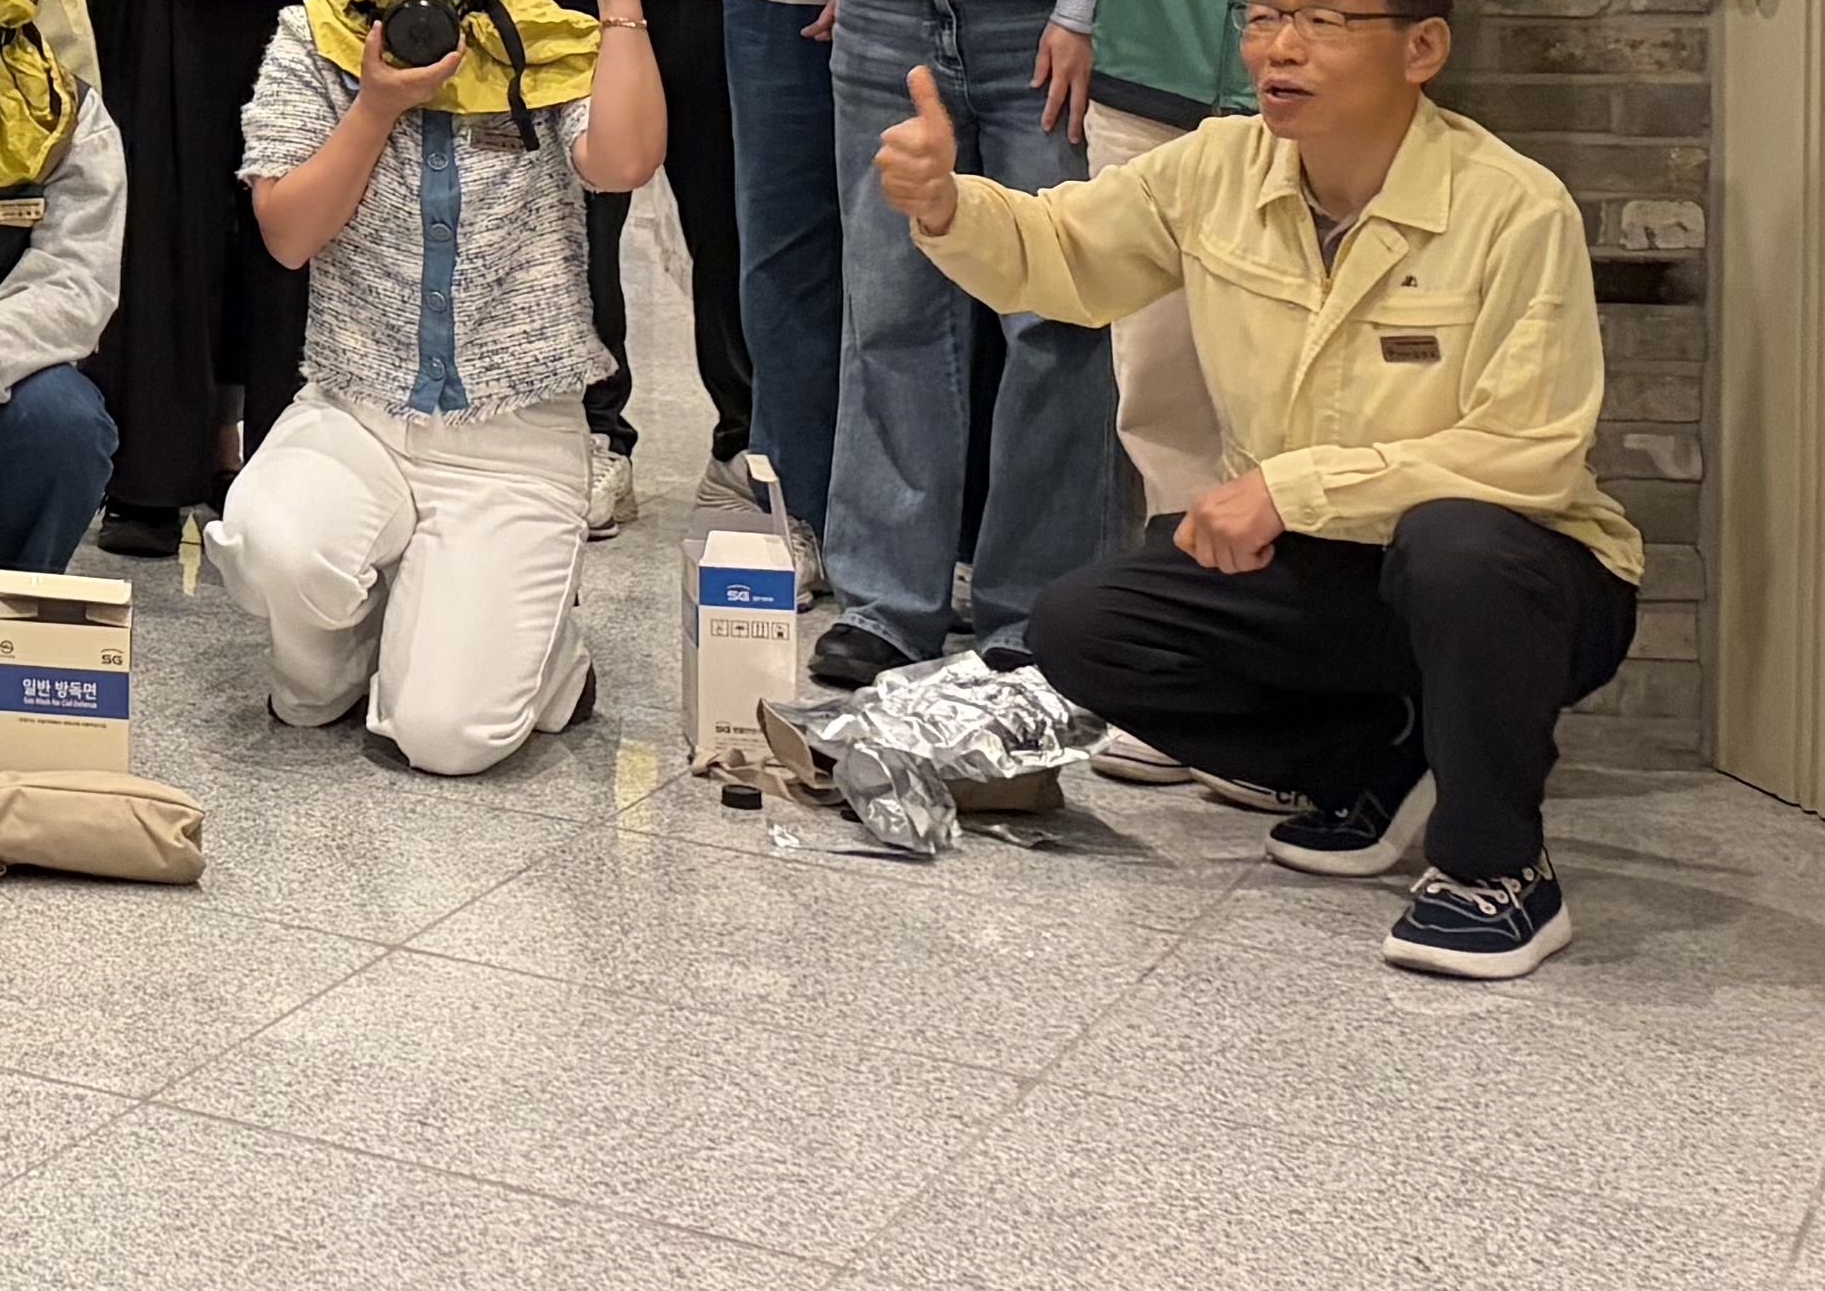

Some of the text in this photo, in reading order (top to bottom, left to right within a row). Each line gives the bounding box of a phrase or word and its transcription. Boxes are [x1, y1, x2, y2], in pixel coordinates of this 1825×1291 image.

[727, 590, 750, 602] SG
[101, 654, 123, 666] SG
[22, 678, 97, 700] 일반 방독면
